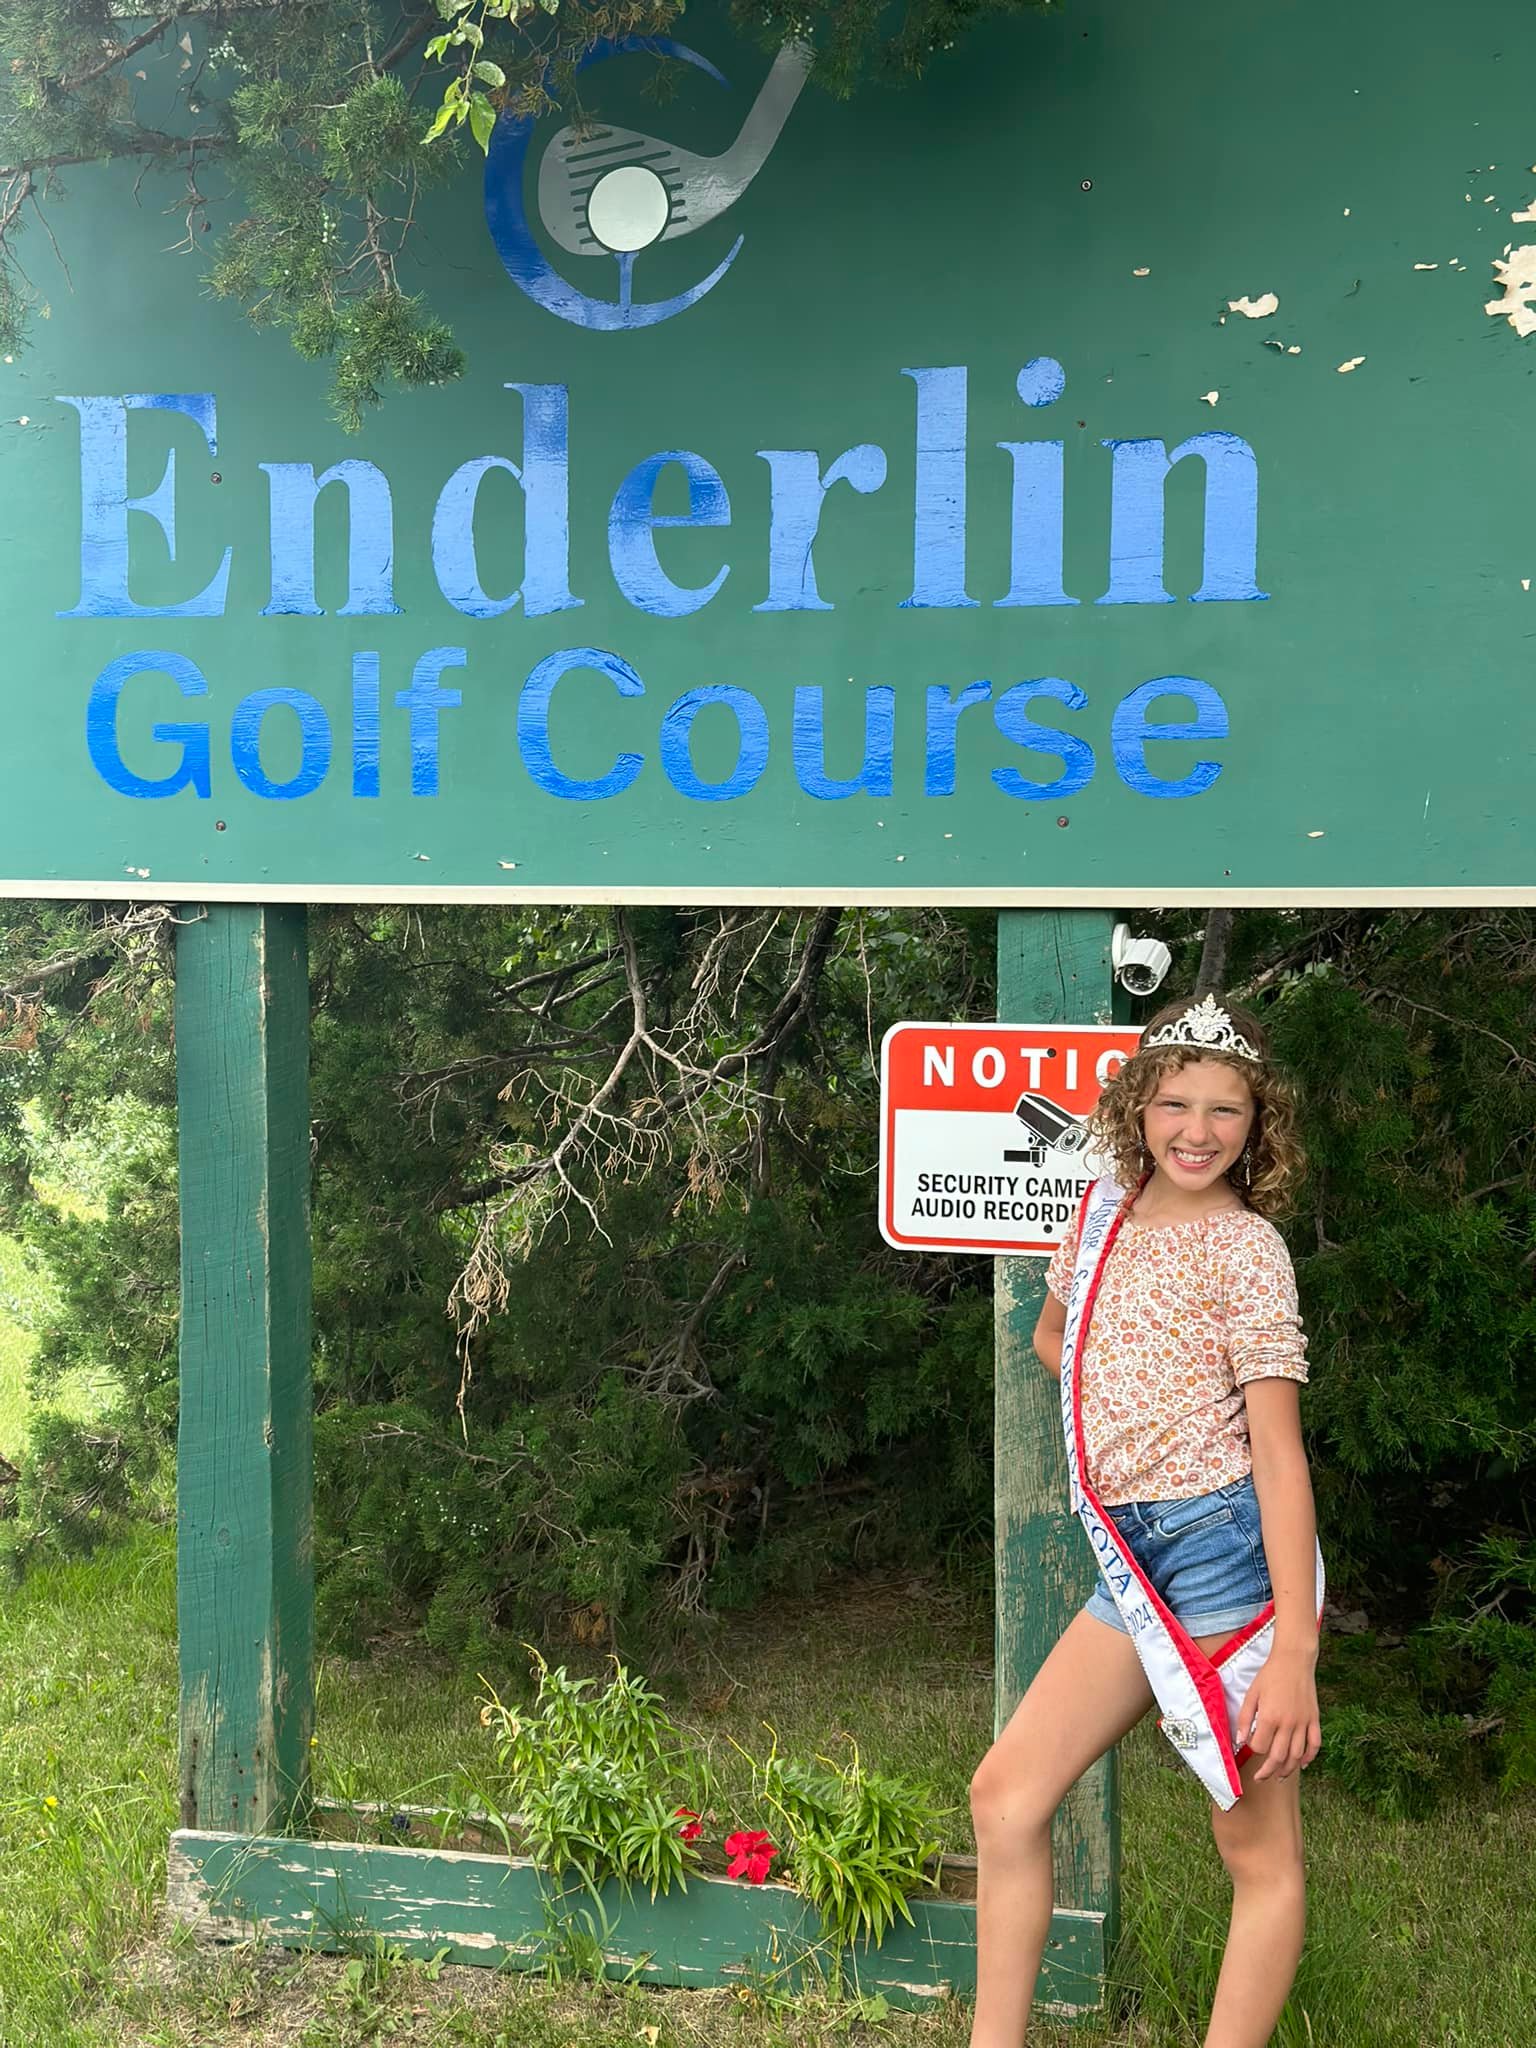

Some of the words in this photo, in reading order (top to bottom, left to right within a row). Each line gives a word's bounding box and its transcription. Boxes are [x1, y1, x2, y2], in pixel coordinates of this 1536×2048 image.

[55, 356, 1270, 618] Enderlin
[86, 646, 467, 800] Golf
[516, 646, 1230, 802] Course
[911, 1198, 976, 1219] AUDIO
[917, 1173, 1019, 1196] SECURITY
[1025, 1176, 1094, 1198] CAME
[1085, 1197, 1118, 1250] JUNIOR
